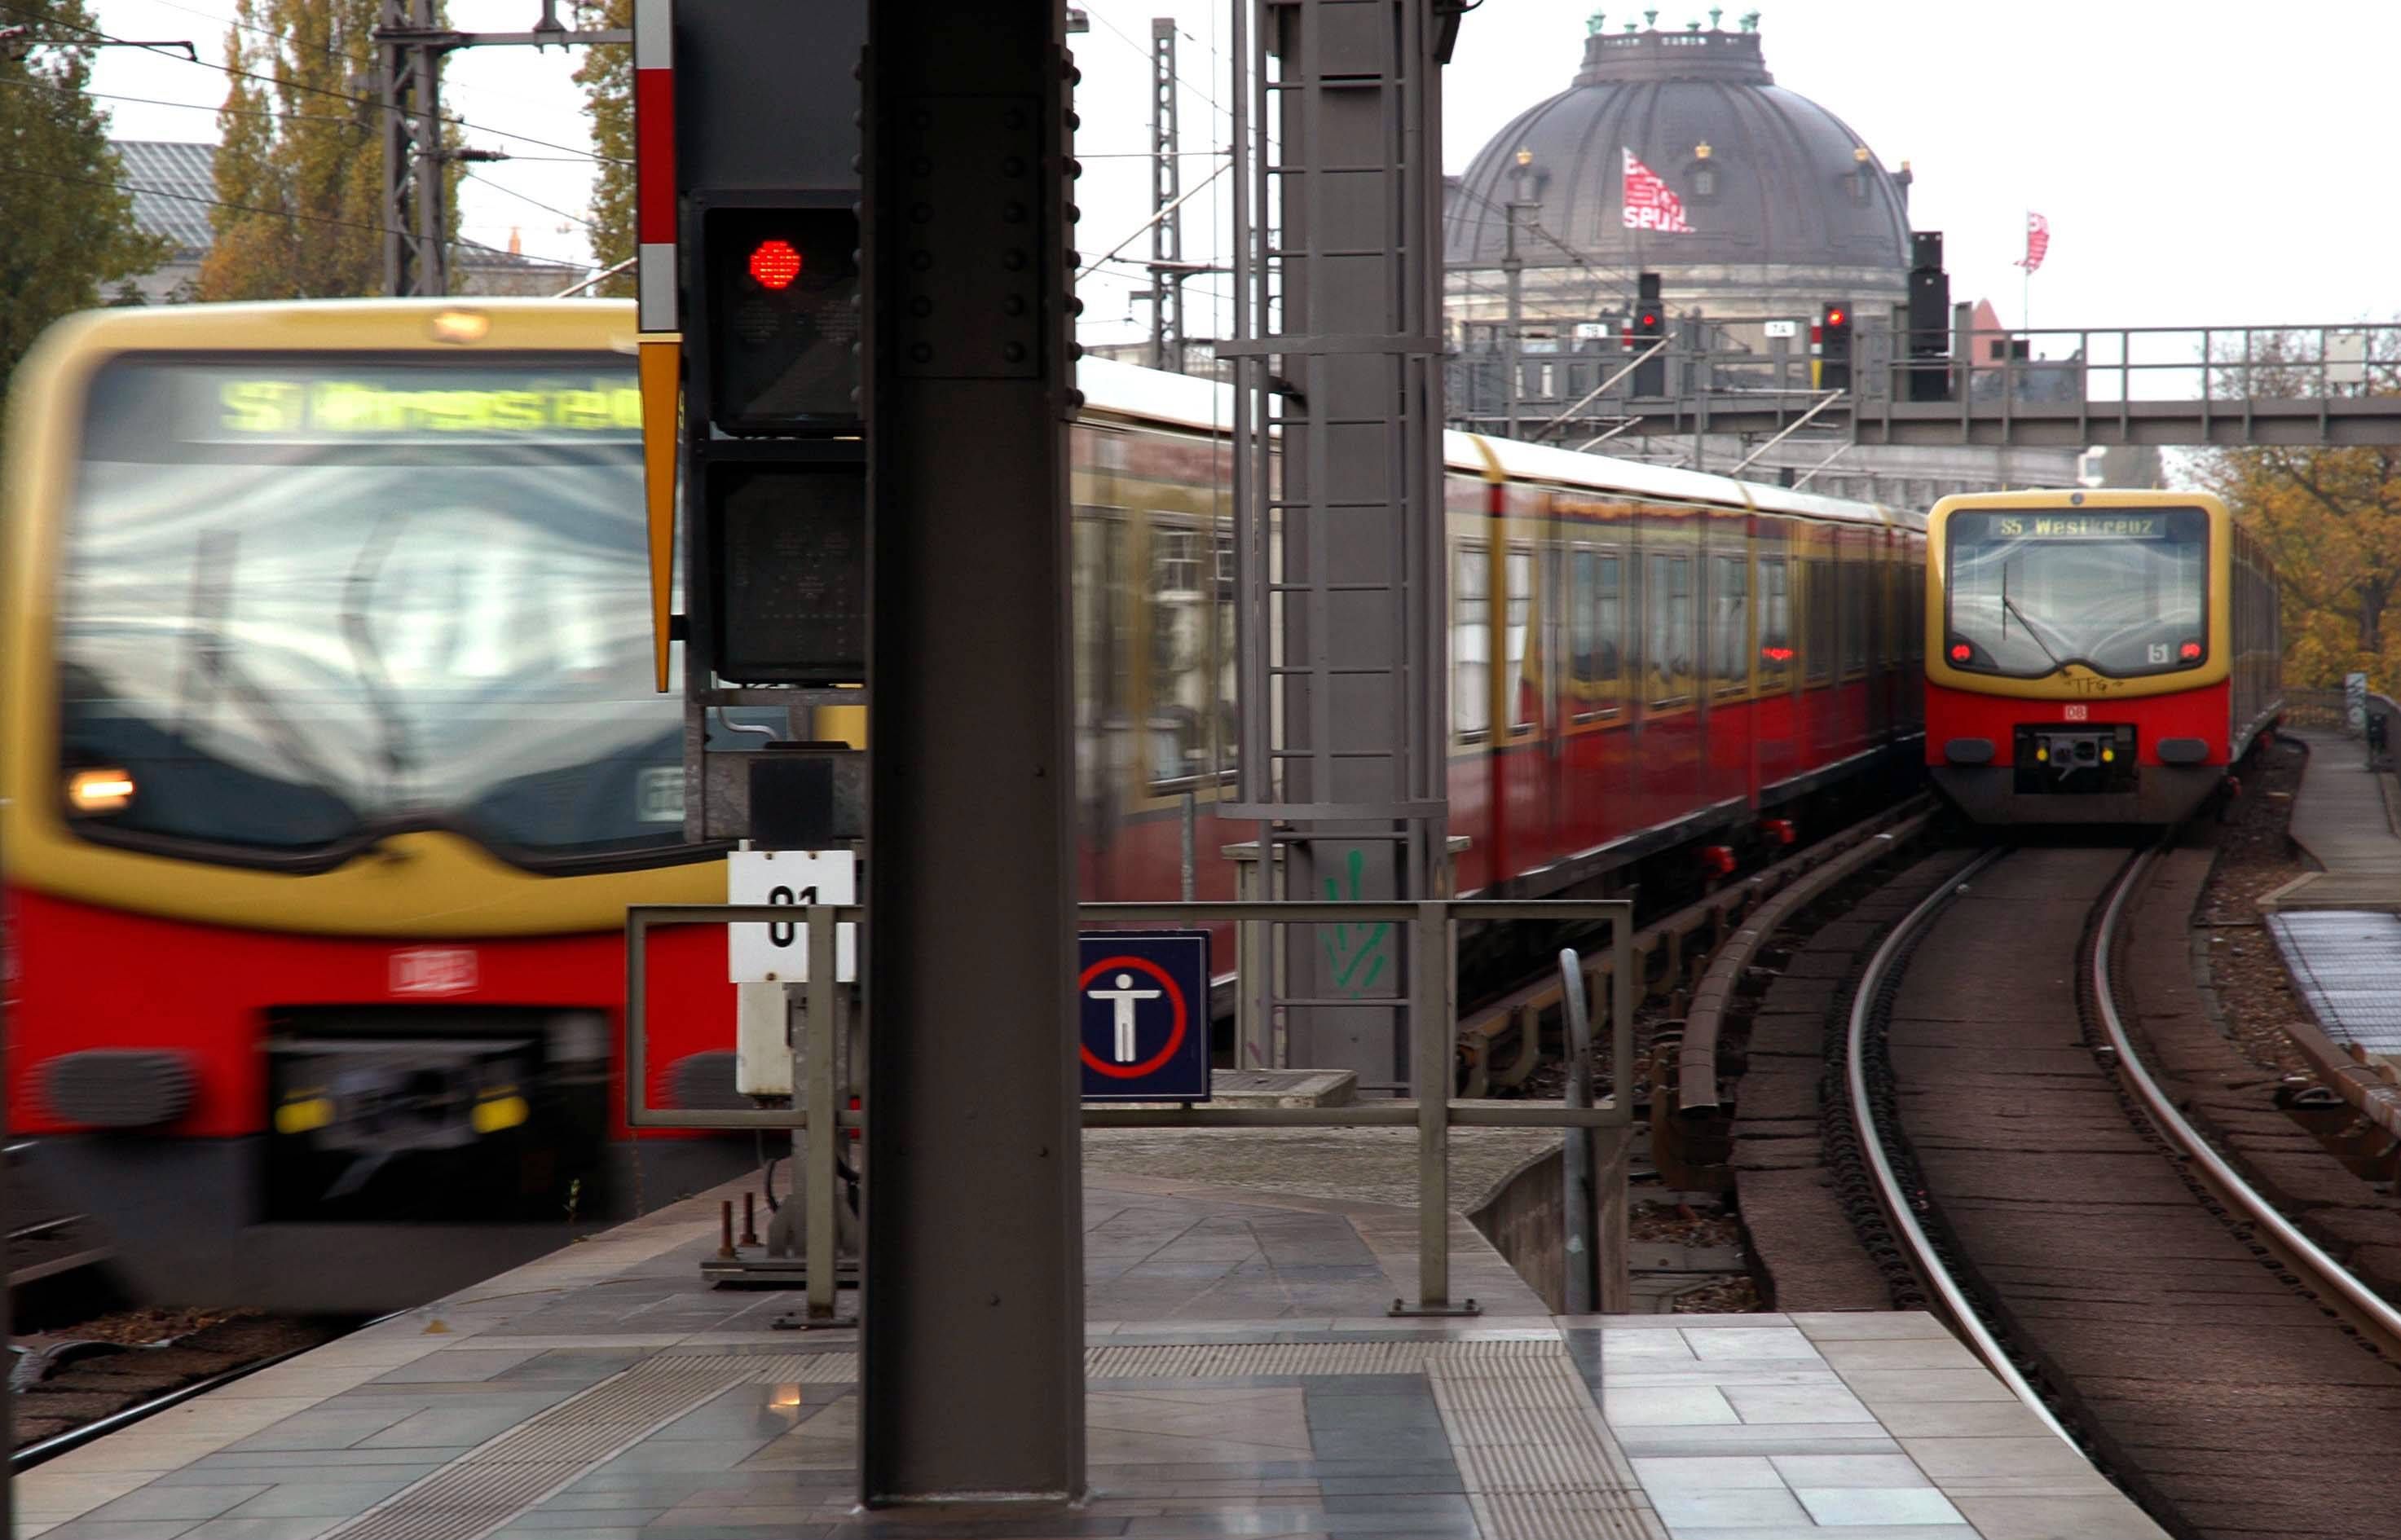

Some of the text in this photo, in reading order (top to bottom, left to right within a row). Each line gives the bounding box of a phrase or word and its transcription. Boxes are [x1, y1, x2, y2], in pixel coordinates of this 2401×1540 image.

[2002, 517, 2153, 535] S5 Westkreuz
[2066, 705, 2086, 719] DB
